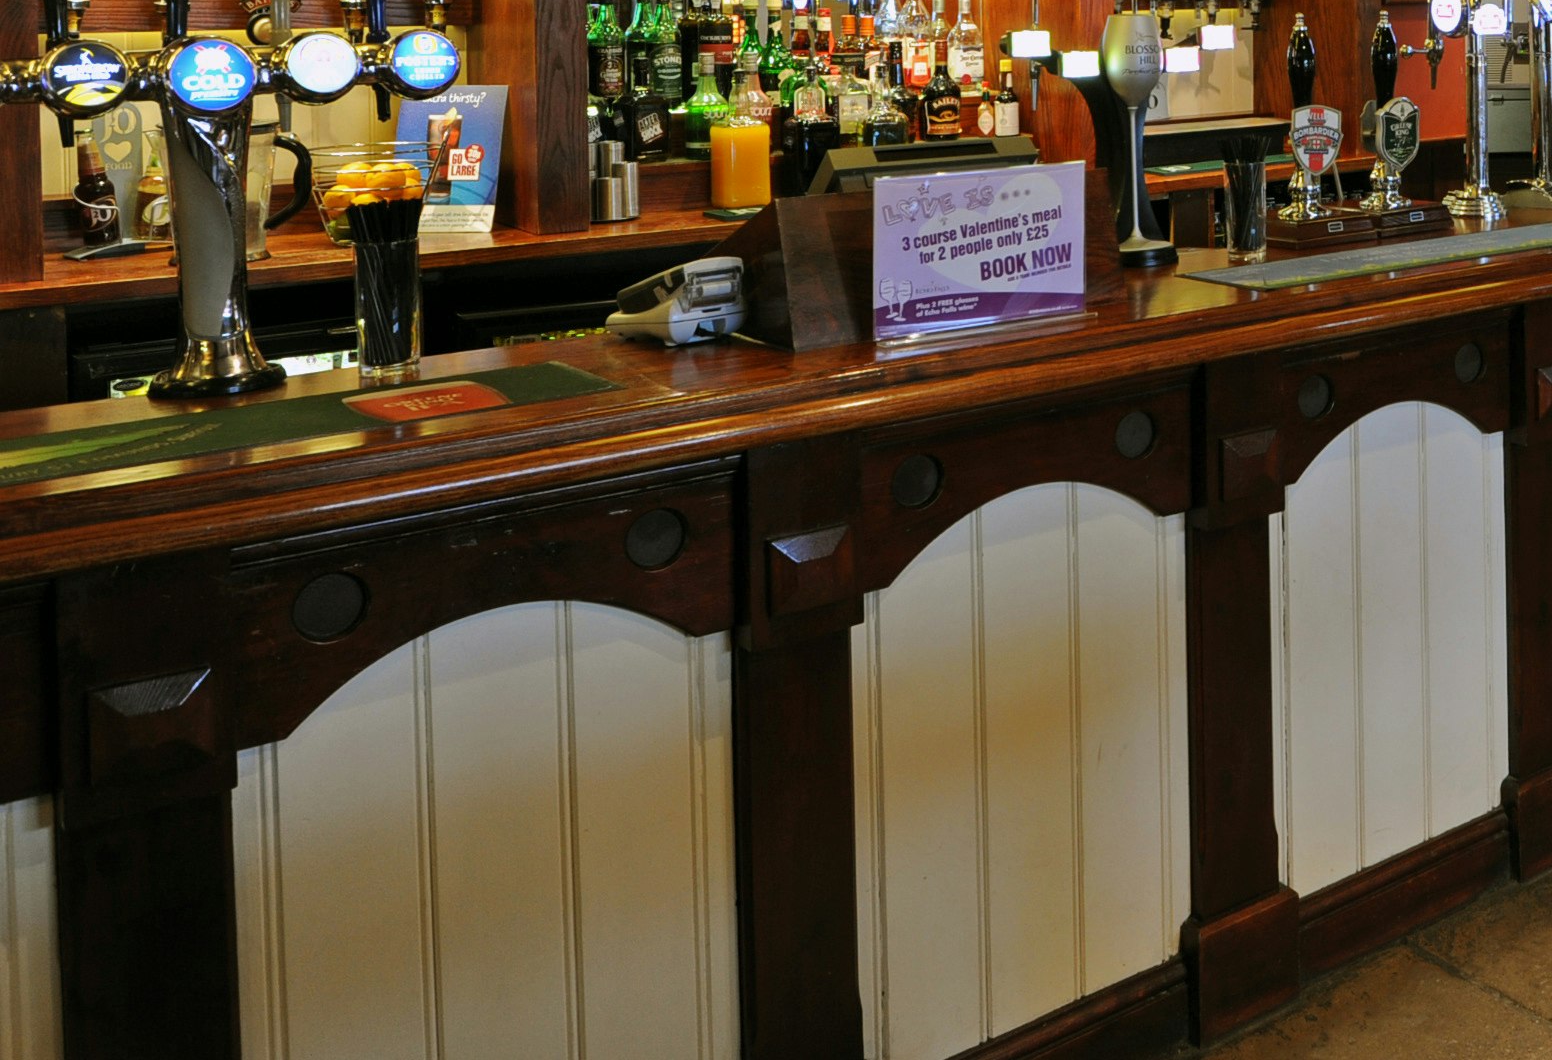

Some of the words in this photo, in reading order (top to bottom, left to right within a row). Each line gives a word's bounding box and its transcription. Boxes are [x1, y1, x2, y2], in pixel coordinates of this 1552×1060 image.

[1125, 44, 1160, 55] BLOSSO
[182, 73, 246, 91] COLD
[449, 92, 487, 108] thirsty?
[1293, 126, 1339, 140] BOMBARDIER
[452, 153, 462, 164] GO
[451, 165, 476, 176] LARGE
[902, 236, 910, 251] 3
[913, 229, 958, 249] course
[960, 213, 1029, 239] Valentine's
[1032, 205, 1062, 224] meal
[918, 250, 935, 265] for
[938, 247, 946, 261] 2
[949, 236, 994, 260] people
[997, 230, 1023, 248] only
[1026, 224, 1050, 242] £25
[980, 252, 1029, 281] BOOK
[1032, 242, 1073, 270] NOW
[916, 303, 931, 311] Plus
[931, 301, 937, 309] 2
[938, 299, 953, 308] FREE
[954, 296, 979, 307] glasses
[924, 308, 942, 317] Echo
[943, 306, 958, 314] Falls
